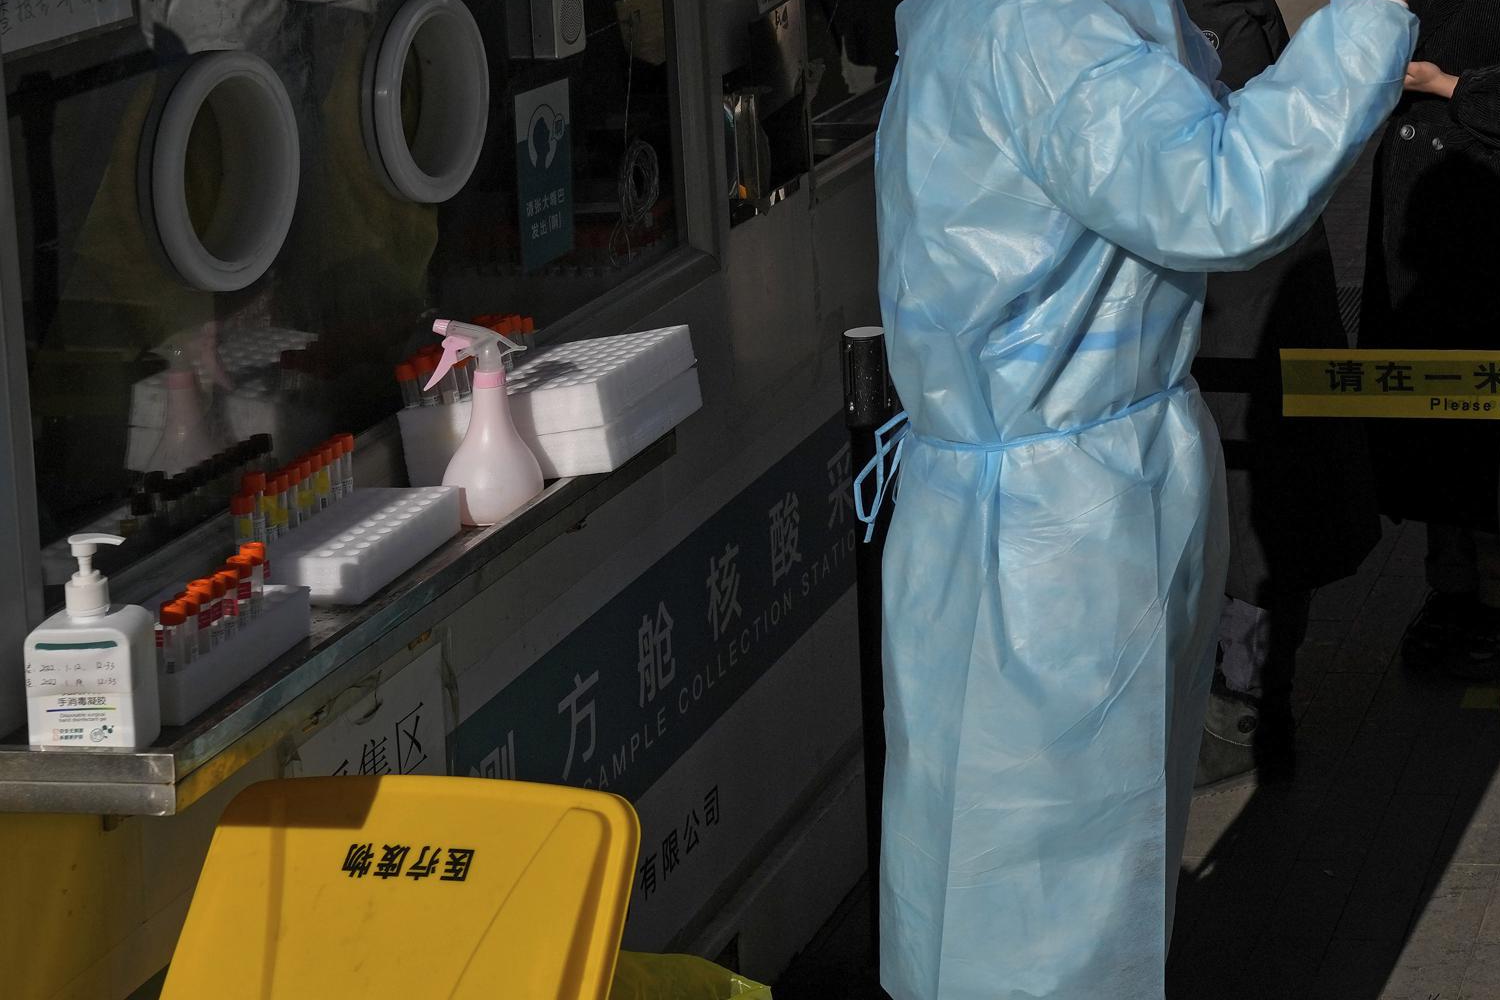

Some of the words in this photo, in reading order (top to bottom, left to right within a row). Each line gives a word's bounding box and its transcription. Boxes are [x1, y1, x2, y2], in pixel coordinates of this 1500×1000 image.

[1430, 397, 1492, 412] Please
[678, 590, 794, 715] COLLECTION
[58, 696, 107, 707] 手消毒凝胶
[341, 842, 475, 882] 医疗废物
[640, 783, 721, 901] 有限公司
